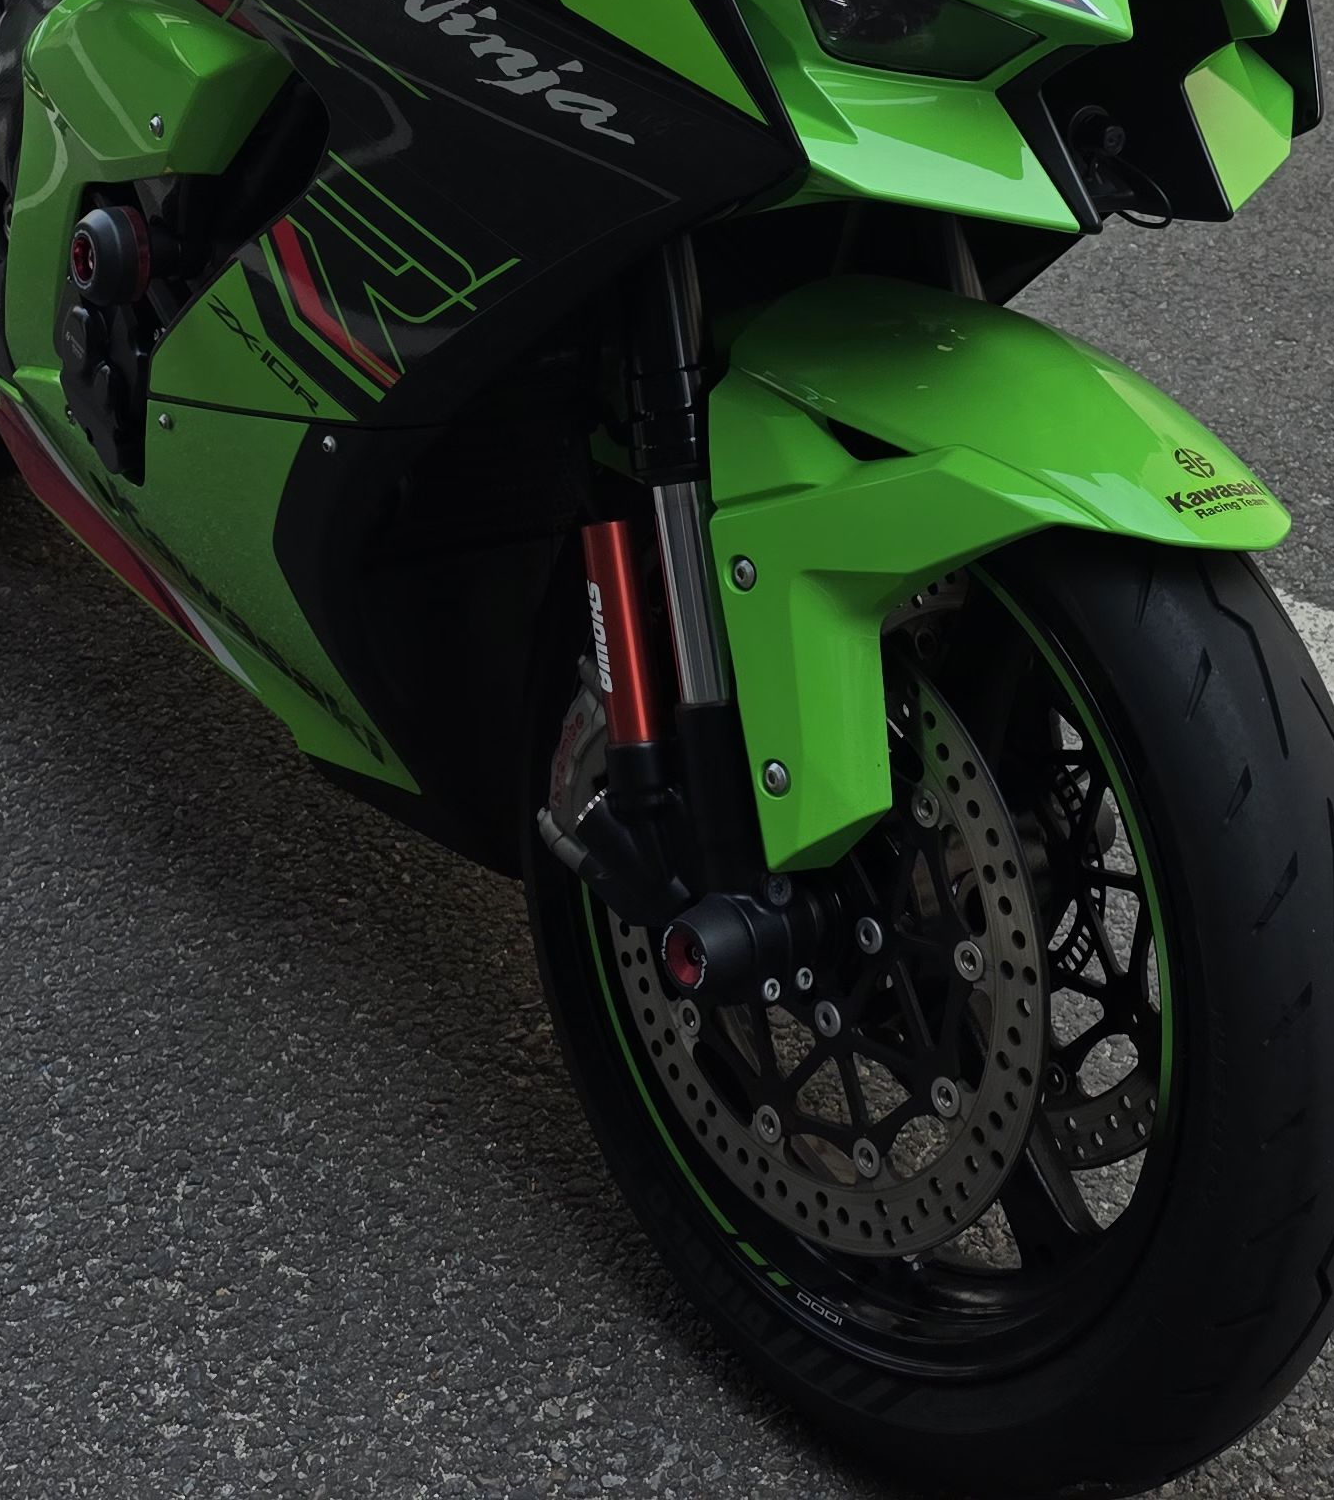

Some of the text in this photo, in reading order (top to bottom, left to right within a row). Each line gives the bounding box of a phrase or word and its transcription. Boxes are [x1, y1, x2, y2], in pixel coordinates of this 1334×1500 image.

[207, 293, 319, 415] ZX-10R
[1165, 479, 1268, 514] Kawasaki
[1194, 500, 1242, 520] Racing
[796, 1291, 843, 1326] 1000
